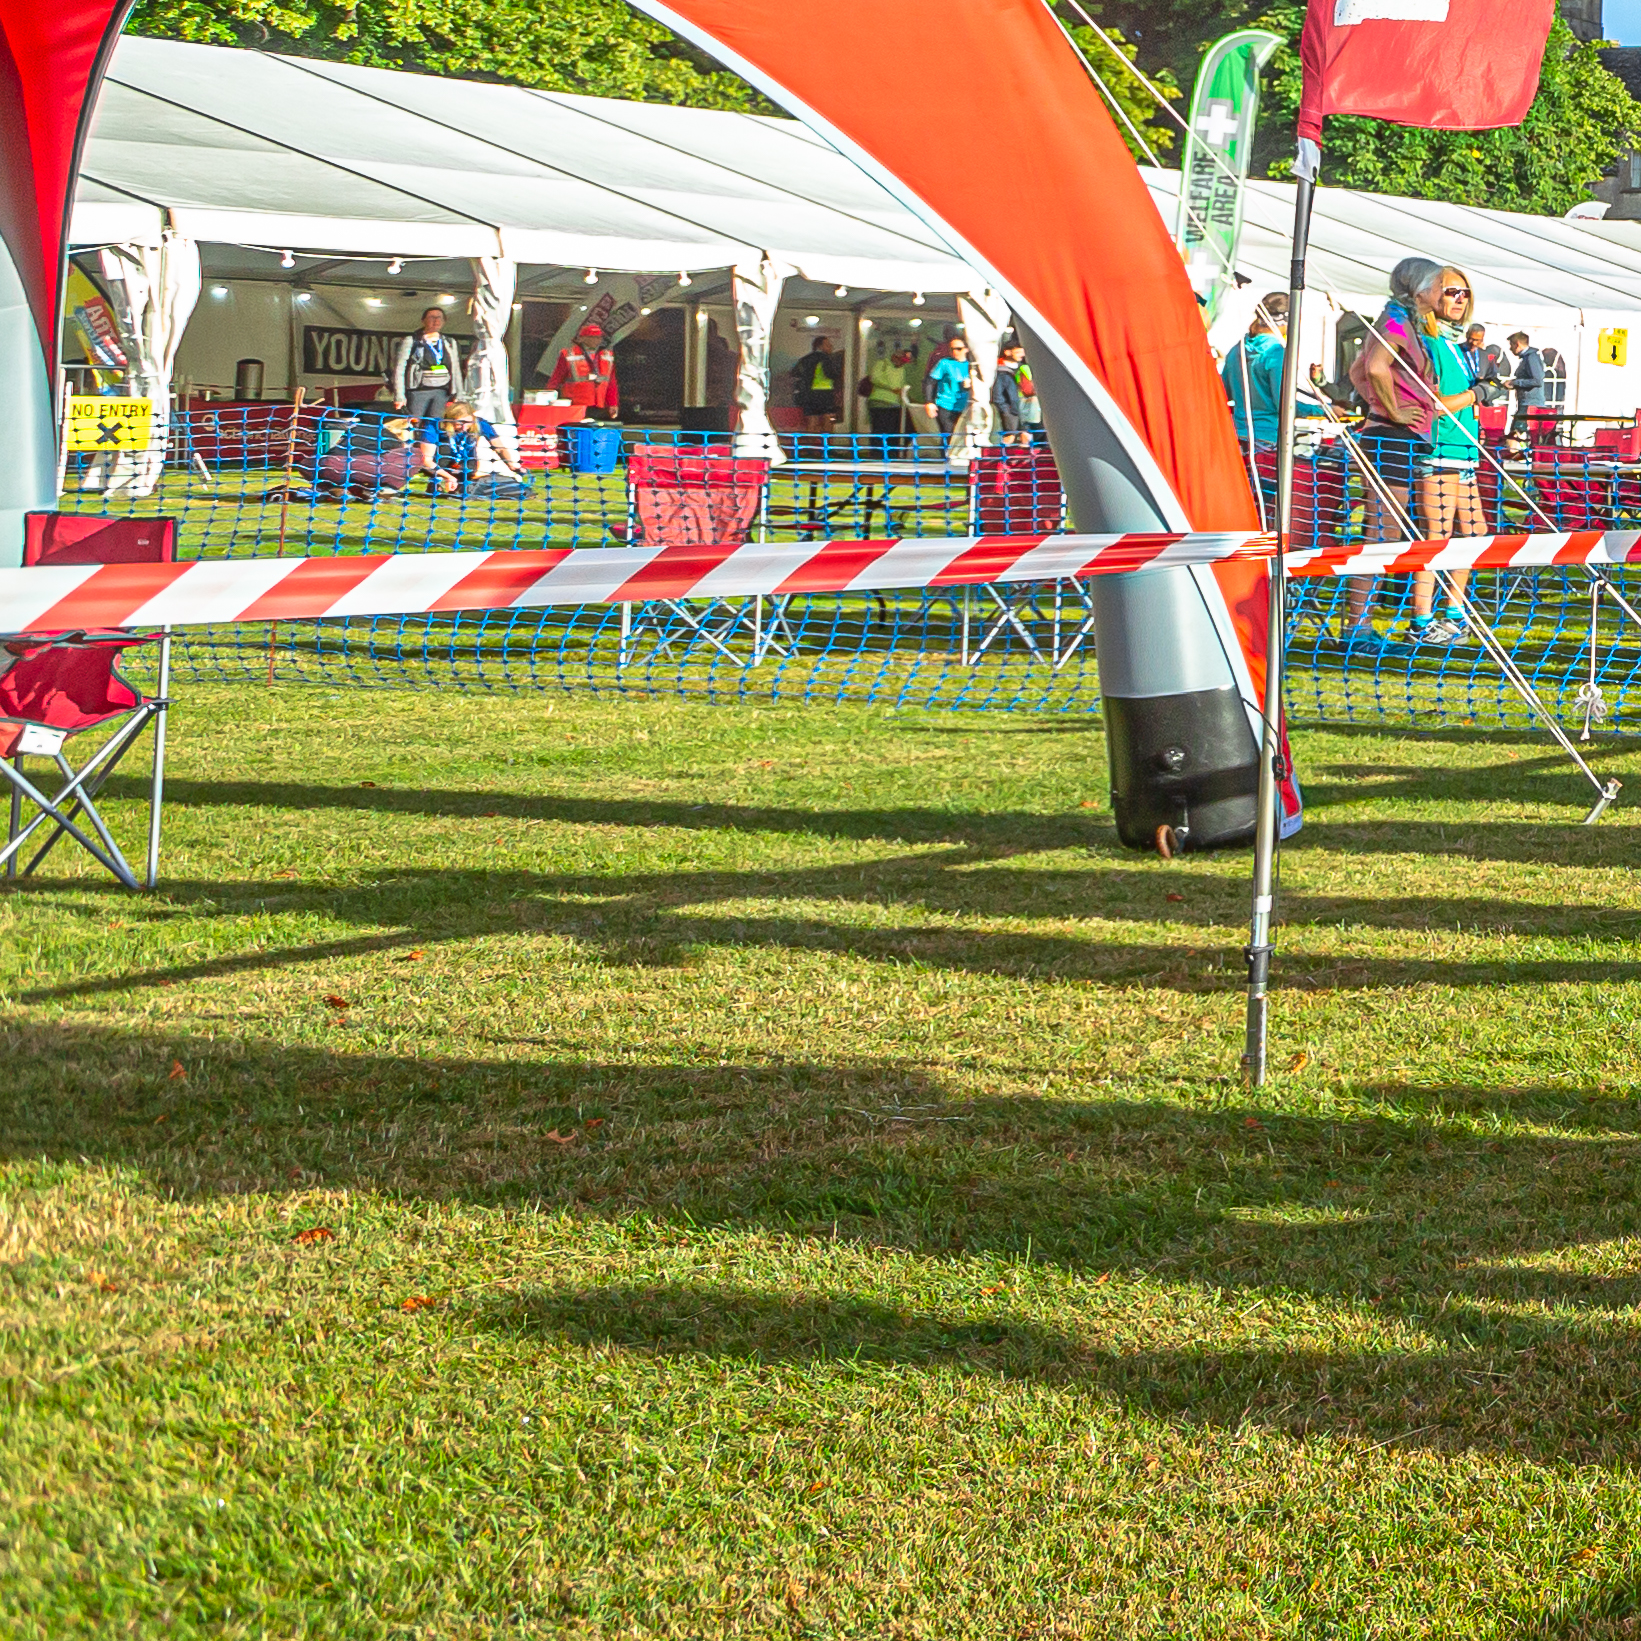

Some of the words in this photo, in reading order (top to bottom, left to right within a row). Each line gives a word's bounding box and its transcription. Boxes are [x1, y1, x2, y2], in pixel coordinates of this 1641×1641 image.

[1185, 151, 1218, 244] WELFARE
[1210, 174, 1238, 227] AREA
[72, 403, 93, 417] NO
[99, 404, 149, 417] ENTRY
